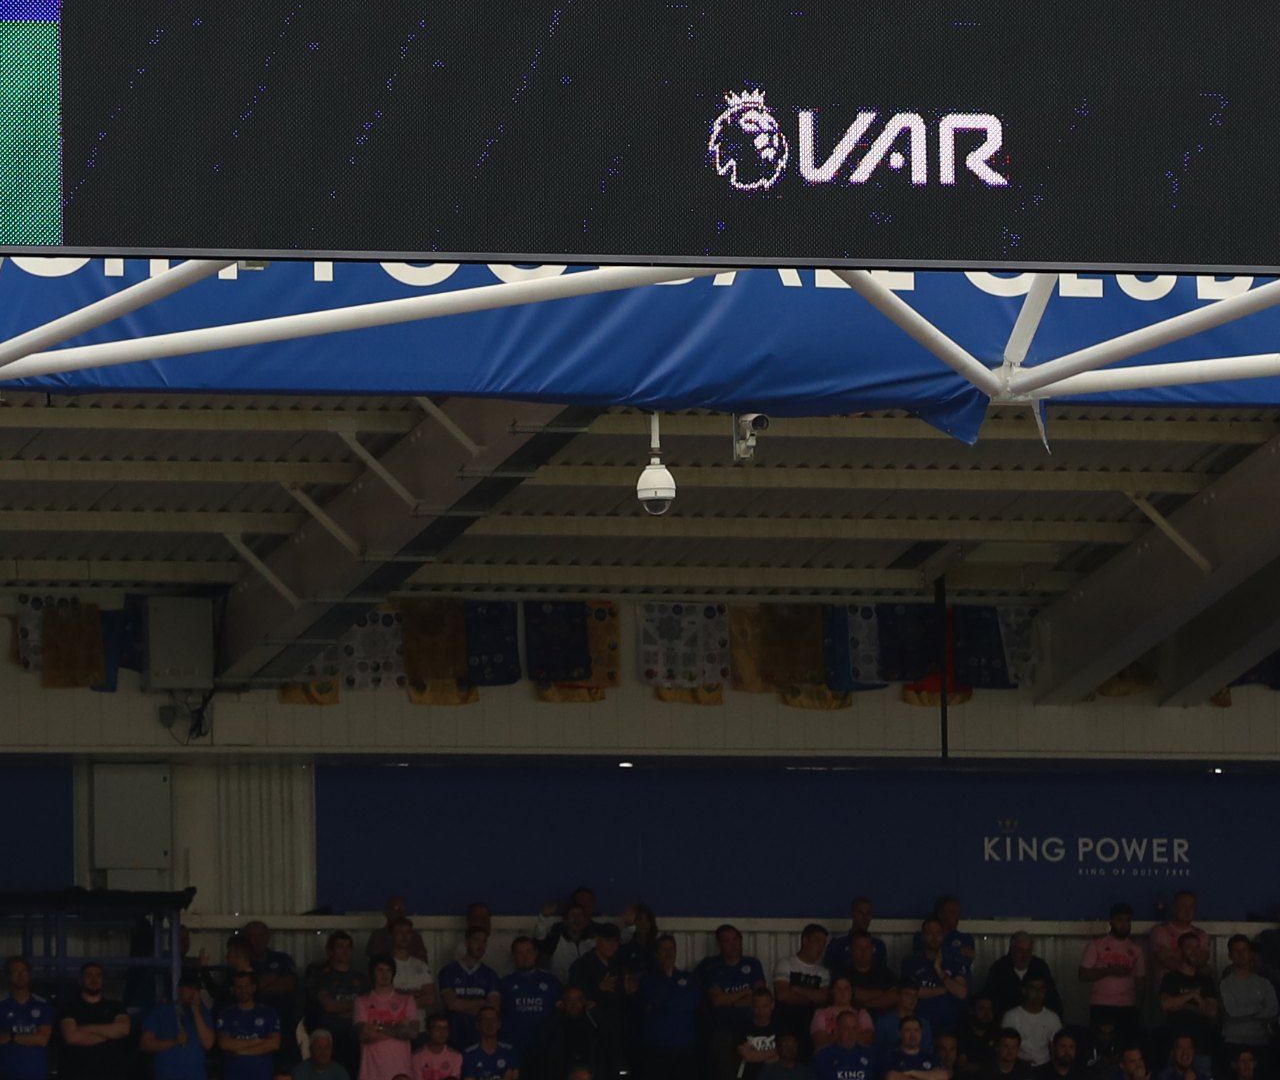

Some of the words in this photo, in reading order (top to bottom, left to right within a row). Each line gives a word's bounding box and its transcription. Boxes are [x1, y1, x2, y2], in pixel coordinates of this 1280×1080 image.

[798, 109, 1009, 186] VAR
[983, 836, 1066, 862] KING
[1078, 837, 1190, 863] POWER
[837, 1070, 865, 1080] KING
